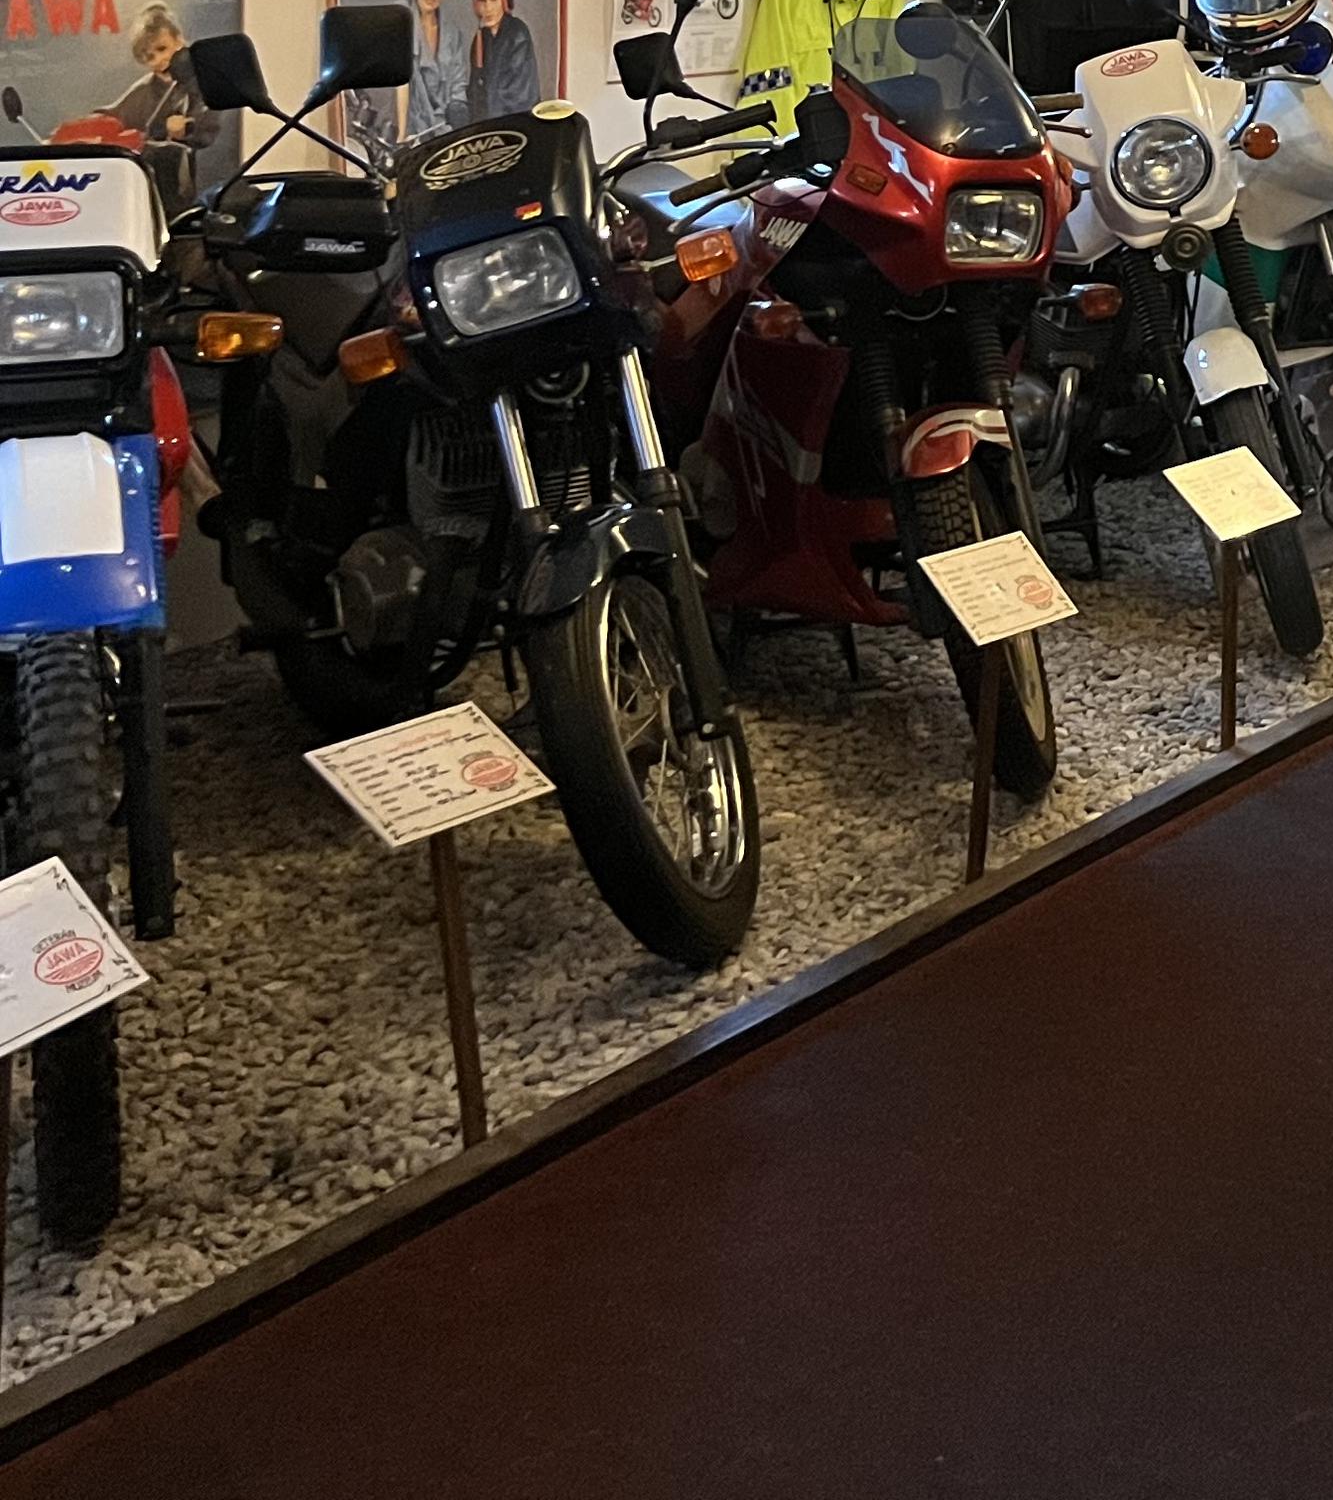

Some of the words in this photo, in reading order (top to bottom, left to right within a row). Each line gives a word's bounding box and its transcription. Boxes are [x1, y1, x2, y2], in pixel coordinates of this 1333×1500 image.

[1110, 50, 1147, 68] JAWA
[441, 135, 505, 164] JAWA
[0, 170, 101, 195] RAMP
[15, 199, 65, 213] JAWA
[46, 942, 88, 971] JAWA
